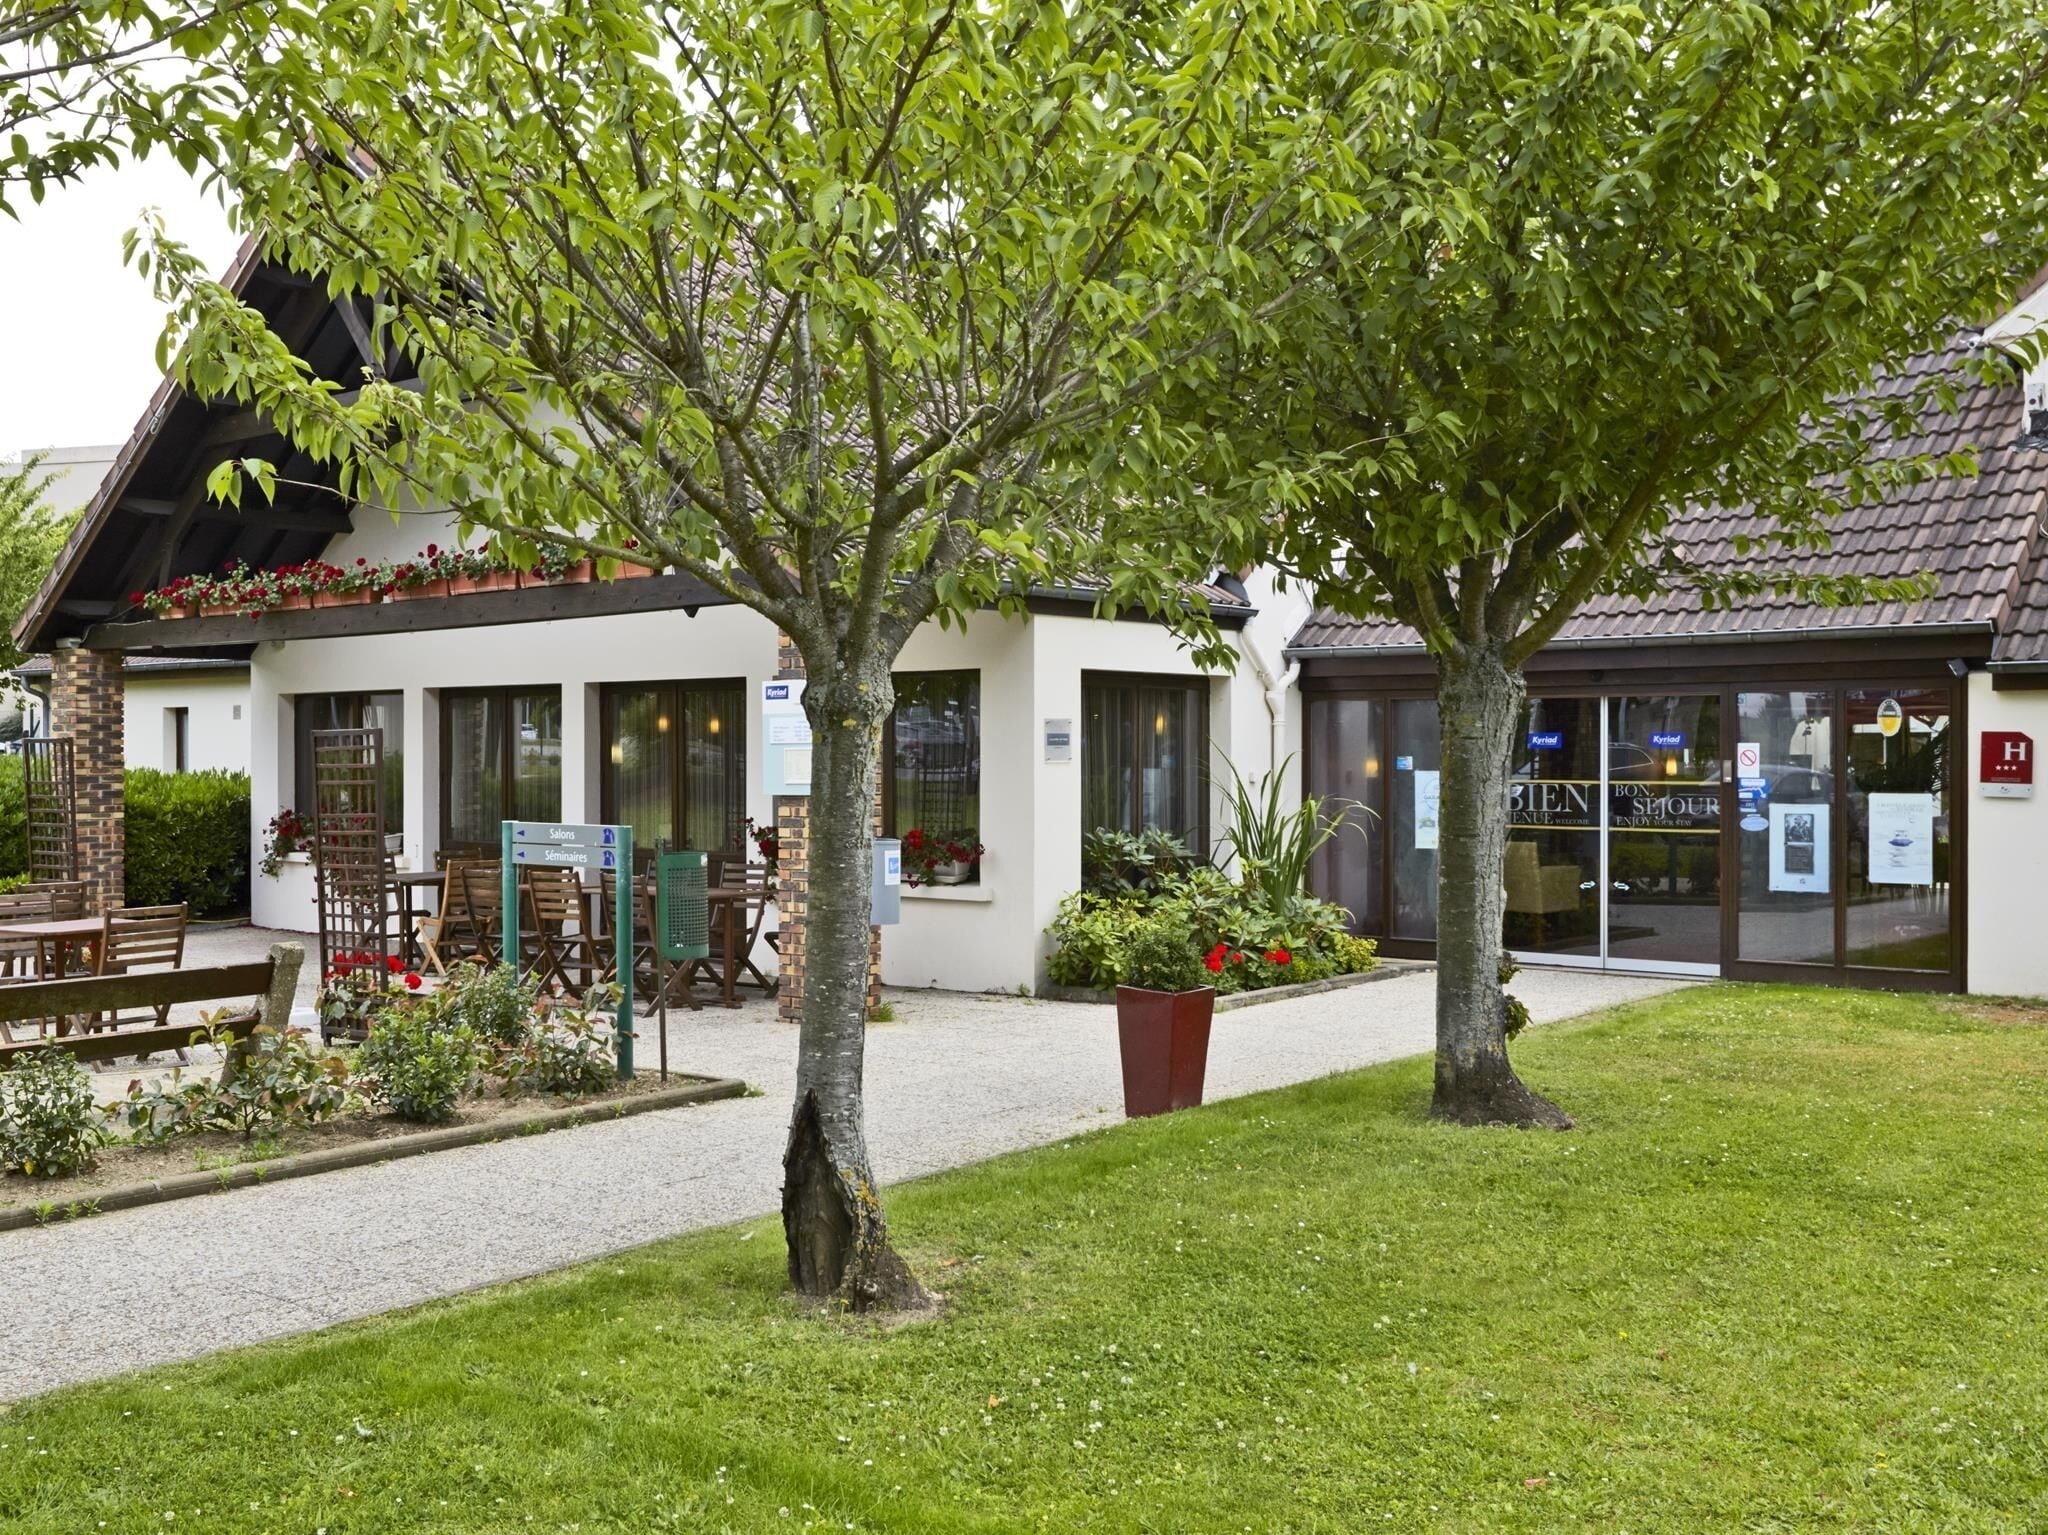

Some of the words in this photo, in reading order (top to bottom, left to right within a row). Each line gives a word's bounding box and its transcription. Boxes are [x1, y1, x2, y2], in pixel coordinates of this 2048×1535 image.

[767, 688, 786, 697] Kyriad
[1532, 736, 1558, 745] Kyriad
[1653, 735, 1681, 745] Kyriad
[2003, 742, 2026, 760] H
[1615, 784, 1650, 797] BON
[1506, 783, 1592, 813] BIEN
[1632, 793, 1720, 820] SÉJOUR
[1509, 811, 1553, 825] ENUE
[1616, 816, 1651, 827] ENJOY
[549, 828, 575, 839] Salons
[545, 850, 588, 863] Séminaires
